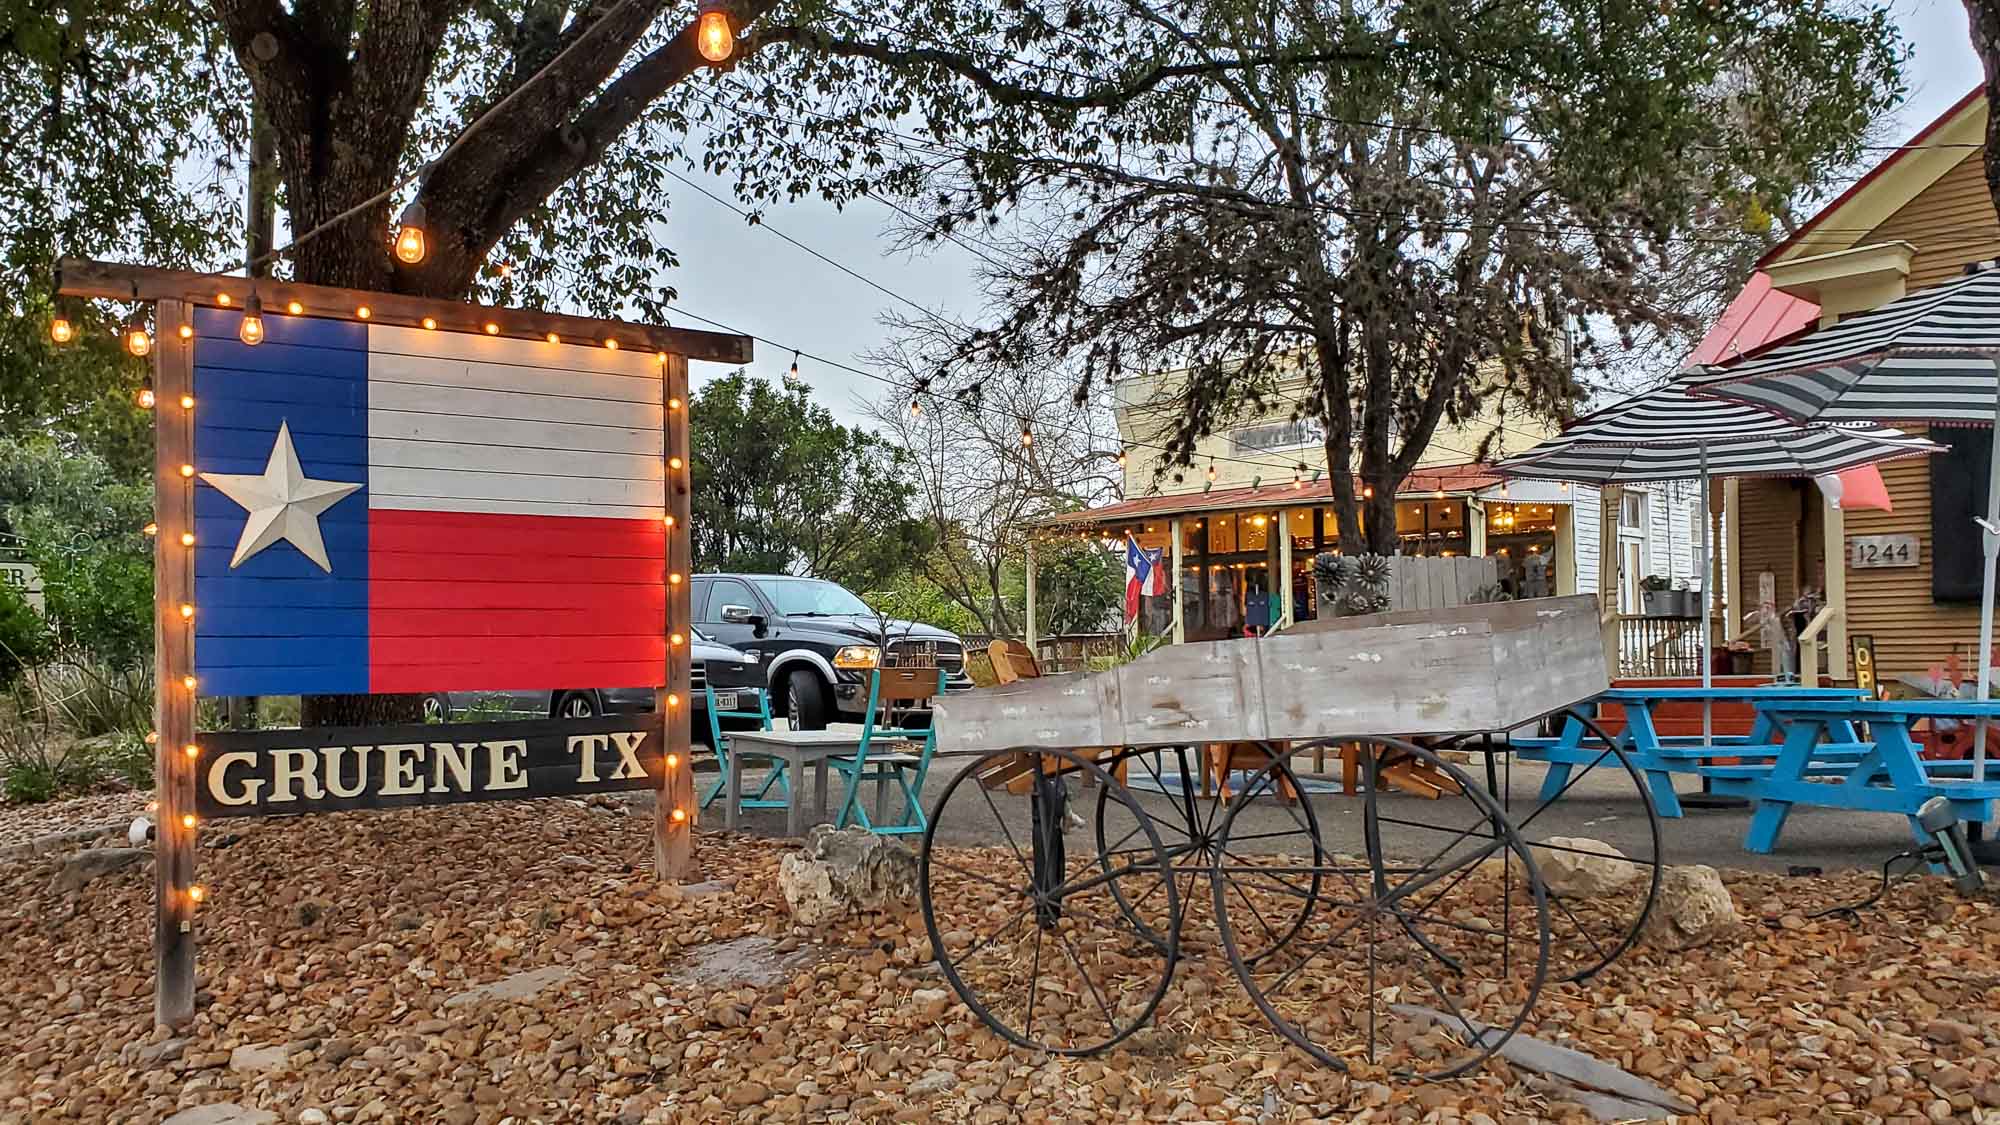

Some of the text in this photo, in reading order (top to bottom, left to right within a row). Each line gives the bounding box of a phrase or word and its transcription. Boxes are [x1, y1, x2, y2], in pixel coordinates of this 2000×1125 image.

[1859, 543, 1908, 562] 1244
[207, 731, 649, 806] GRUENE TX
